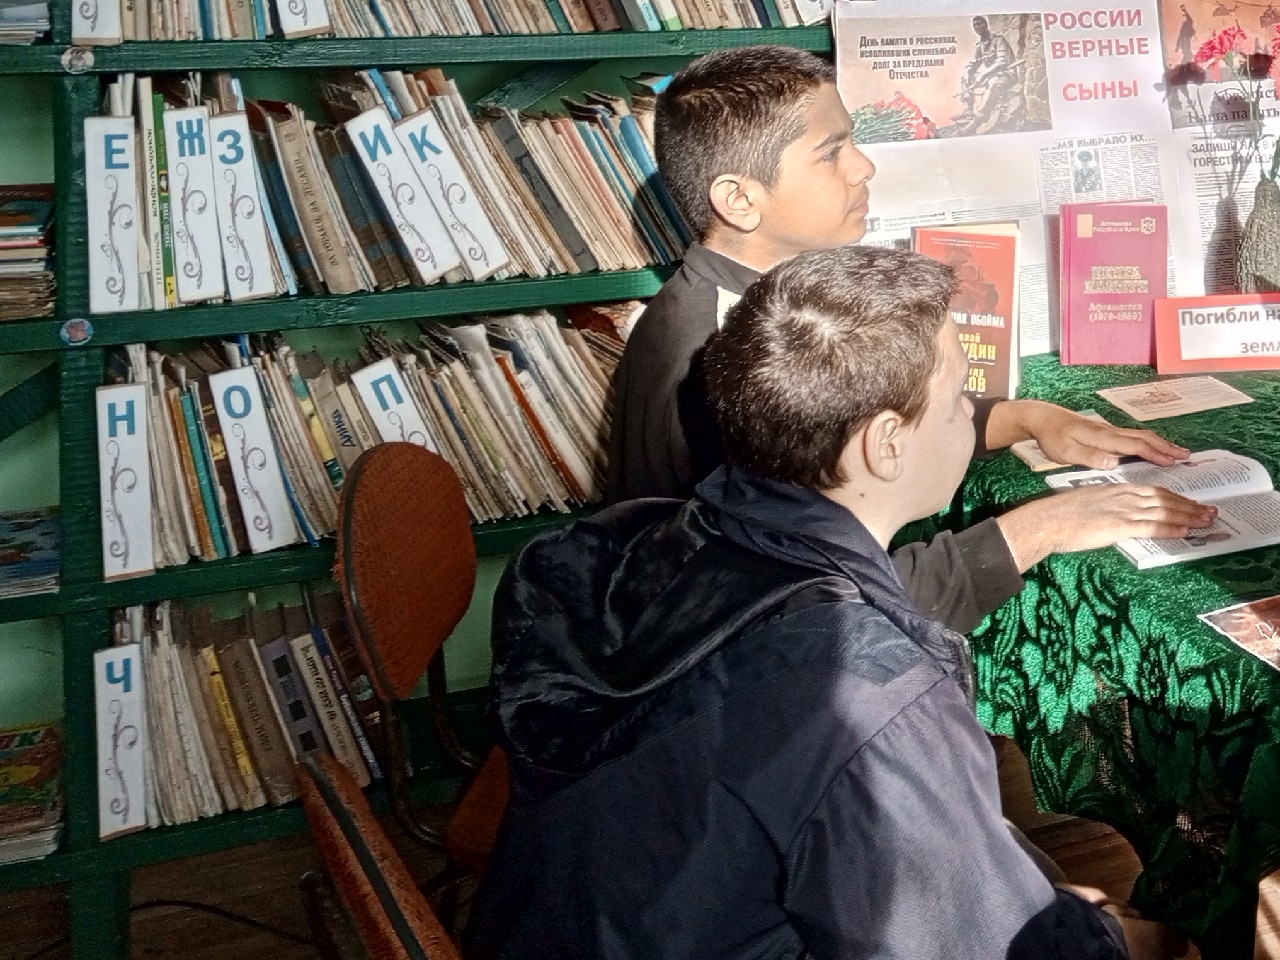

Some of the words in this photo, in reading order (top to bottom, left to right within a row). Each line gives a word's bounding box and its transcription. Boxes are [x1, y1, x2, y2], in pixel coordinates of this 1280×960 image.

[1043, 9, 1143, 31] РОССИИ
[860, 48, 911, 58] ИСПОЛНЯВШИХ
[912, 46, 957, 57] СЛУЖЕБНЫЙ
[880, 37, 907, 47] ПАМЯТИ
[1051, 37, 1150, 59] ВЕРНЫЕ
[872, 60, 890, 70] ДОЛГ
[892, 60, 902, 69] ЗА
[902, 58, 945, 69] ПРЕДЕЛАМИ
[1062, 80, 1140, 102] СЫНЫ
[175, 118, 206, 158] Ж
[216, 129, 244, 164] З
[358, 124, 393, 163] И
[408, 124, 443, 163] К
[1077, 135, 1127, 148] ВЫБРАЛО
[104, 133, 130, 169] Е
[1088, 302, 1143, 313] Афганистан
[1181, 308, 1261, 327] Погибли
[970, 314, 1005, 329] ОБОЙМА
[222, 385, 252, 419] О
[370, 374, 404, 411] П
[107, 399, 136, 437] Н
[105, 658, 132, 693] Ч
